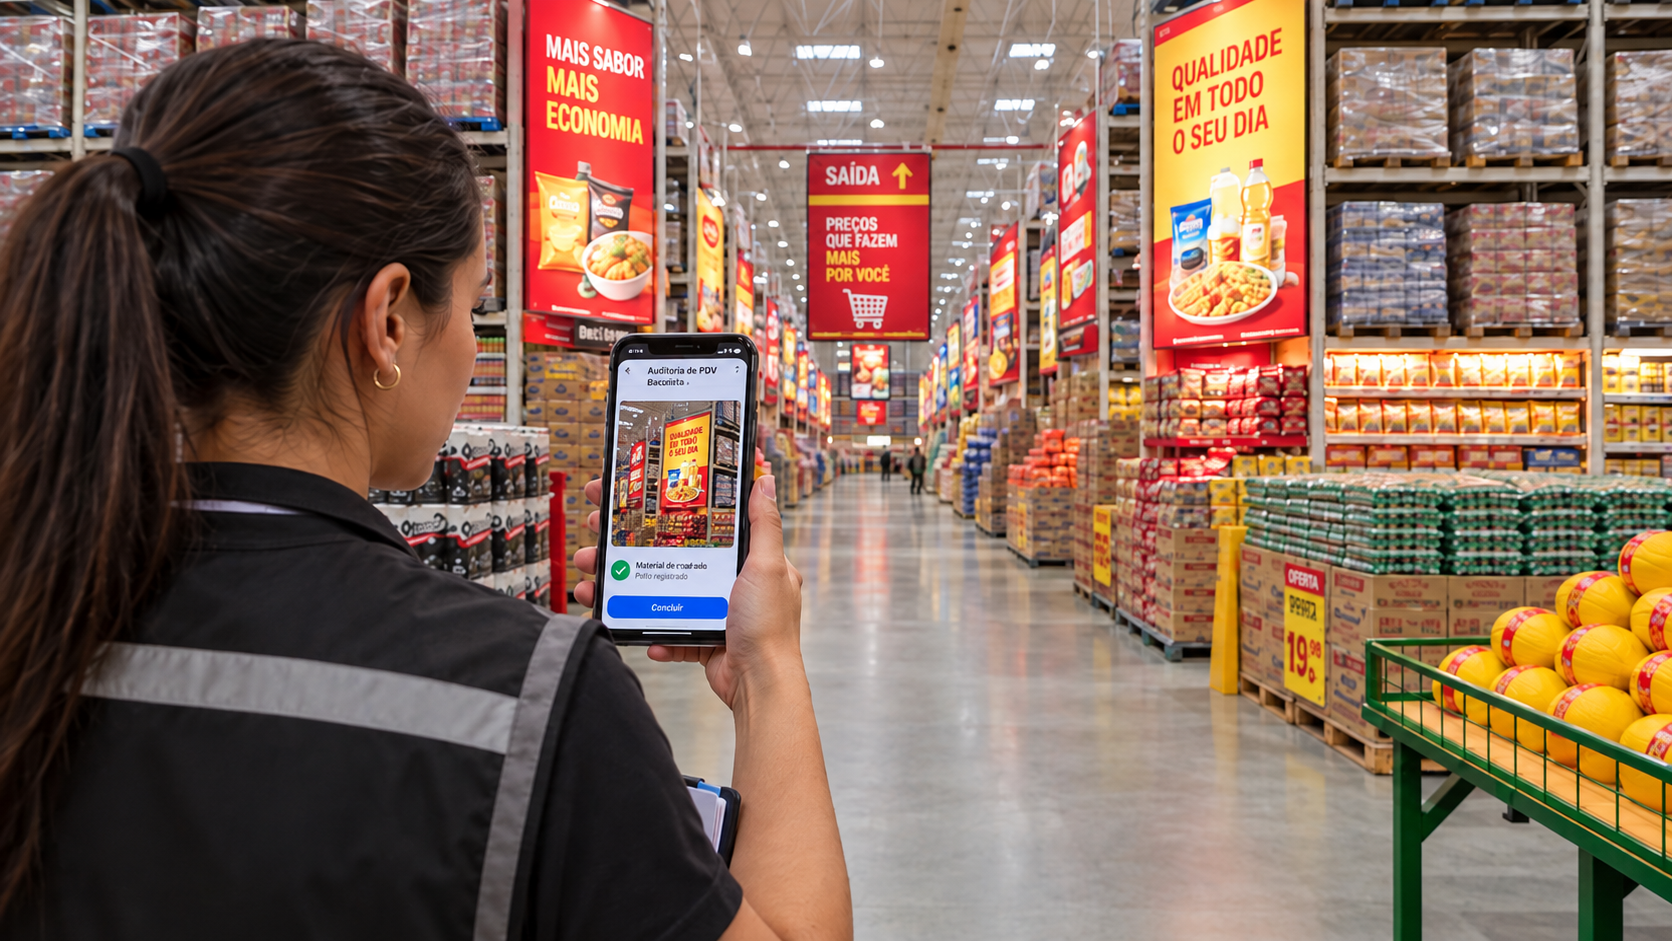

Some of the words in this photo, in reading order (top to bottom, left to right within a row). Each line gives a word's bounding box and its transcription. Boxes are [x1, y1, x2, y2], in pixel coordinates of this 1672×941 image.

[546, 33, 590, 67] MAIS
[593, 45, 645, 79] SABOR
[1172, 27, 1282, 92] QUALIDADE
[546, 65, 600, 103] MAIS
[1173, 90, 1202, 124] EM
[1207, 70, 1264, 112] TODO
[546, 99, 644, 145] ECONOMIA
[1173, 128, 1186, 155] O
[1190, 115, 1227, 150] SEU
[1234, 104, 1269, 138] DIA
[825, 161, 880, 186] SAÍDA
[826, 216, 878, 234] PREÇOS
[826, 233, 853, 249] QUE
[855, 233, 898, 248] FAZEM
[826, 249, 860, 265] MAIS
[826, 267, 853, 282] POR
[856, 264, 890, 282] VOCÊ
[647, 366, 685, 375] Auditoria
[686, 366, 697, 375] de
[699, 366, 718, 375] PDV
[635, 561, 665, 570] Material
[666, 562, 675, 570] de
[1288, 568, 1319, 591] OFERTA
[651, 603, 684, 612] Concluir
[1287, 631, 1308, 675] 19
